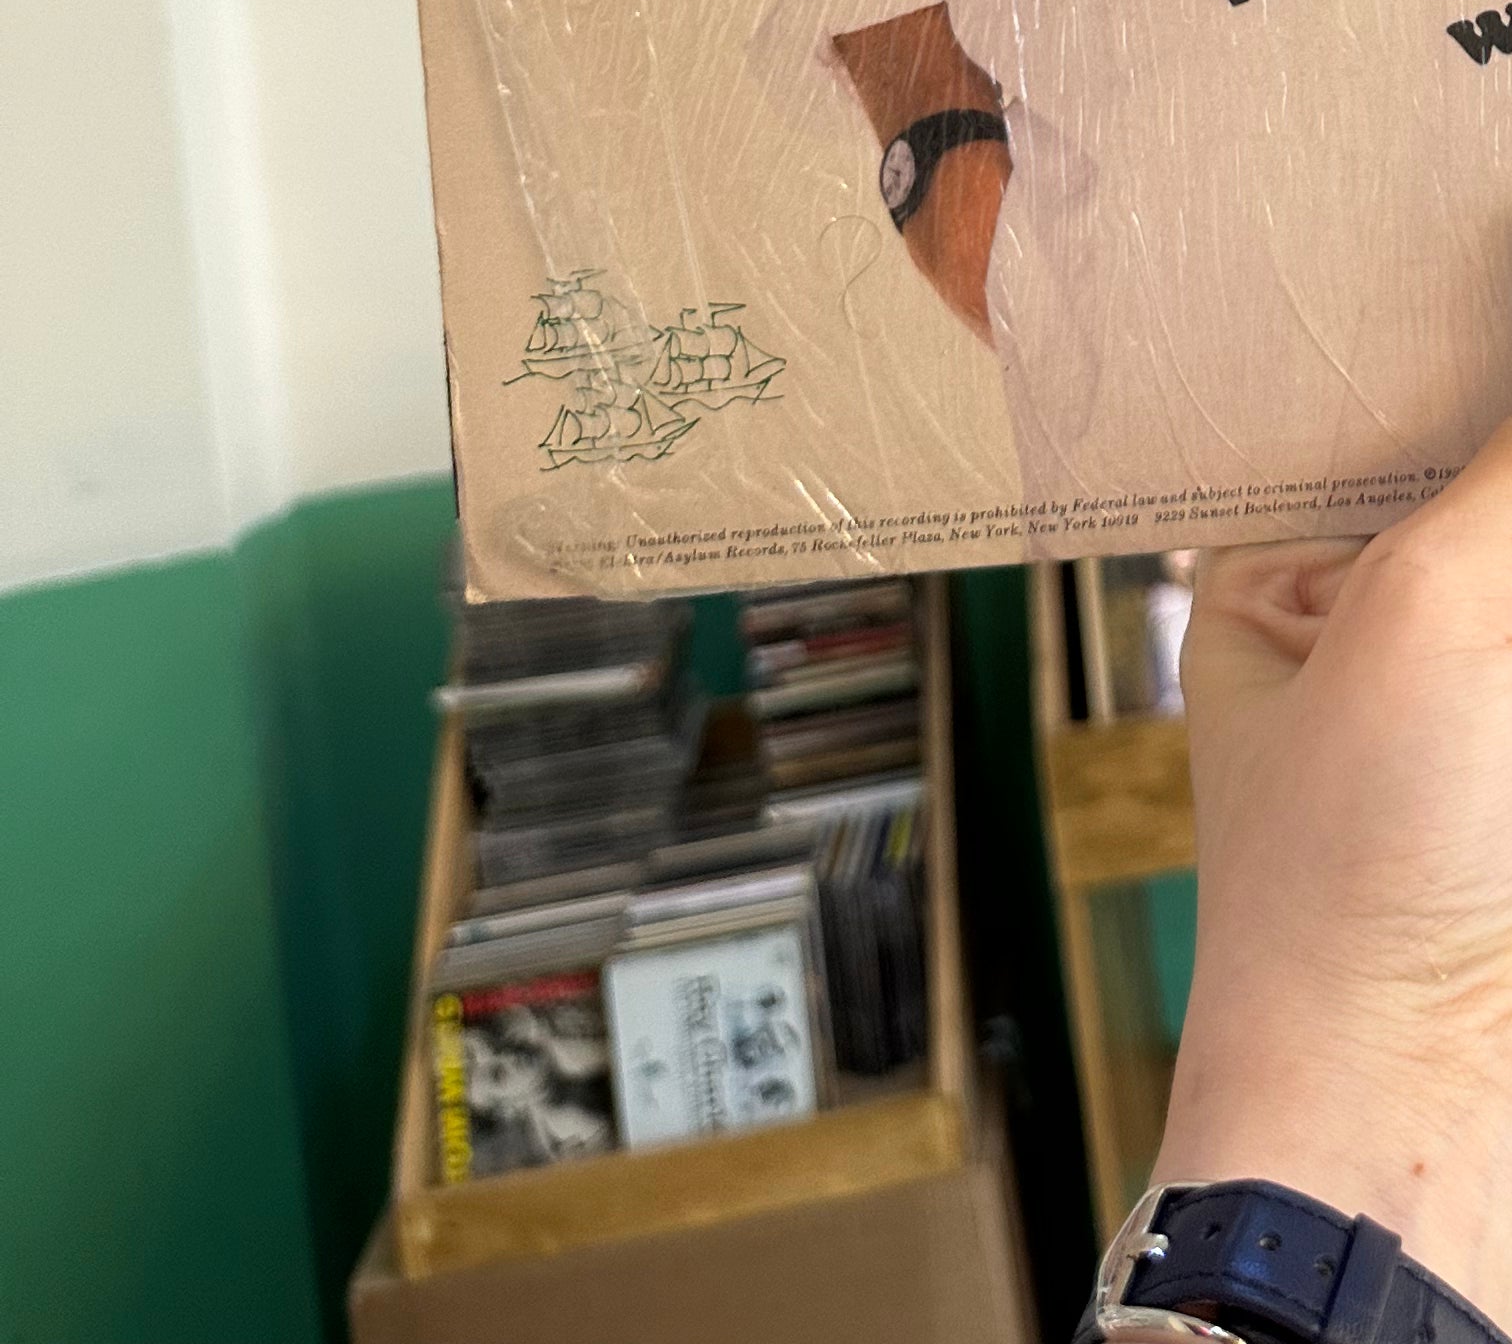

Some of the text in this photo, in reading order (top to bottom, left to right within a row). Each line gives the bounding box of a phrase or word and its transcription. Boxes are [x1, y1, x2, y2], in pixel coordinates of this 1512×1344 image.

[600, 548, 721, 569] Elktra/Asylum
[949, 525, 981, 542] New
[1027, 520, 1058, 535] New
[1064, 516, 1097, 531] York
[1154, 510, 1186, 524] 9229
[1188, 504, 1240, 521] Sunset
[1326, 494, 1351, 509] Los
[1355, 489, 1416, 507] Angeles,
[626, 528, 727, 548] Unauthorized
[731, 522, 826, 542] reproduction
[830, 518, 845, 534] of
[847, 516, 875, 531] this
[879, 511, 951, 529] recording
[954, 511, 967, 523] is
[970, 501, 1047, 524] prohibited
[1050, 500, 1068, 516] by
[1073, 494, 1129, 512] Federal
[1132, 493, 1158, 507] law
[1160, 489, 1187, 504] and
[1191, 485, 1244, 503] subject
[1247, 484, 1261, 497] to
[1264, 477, 1327, 494] criminal
